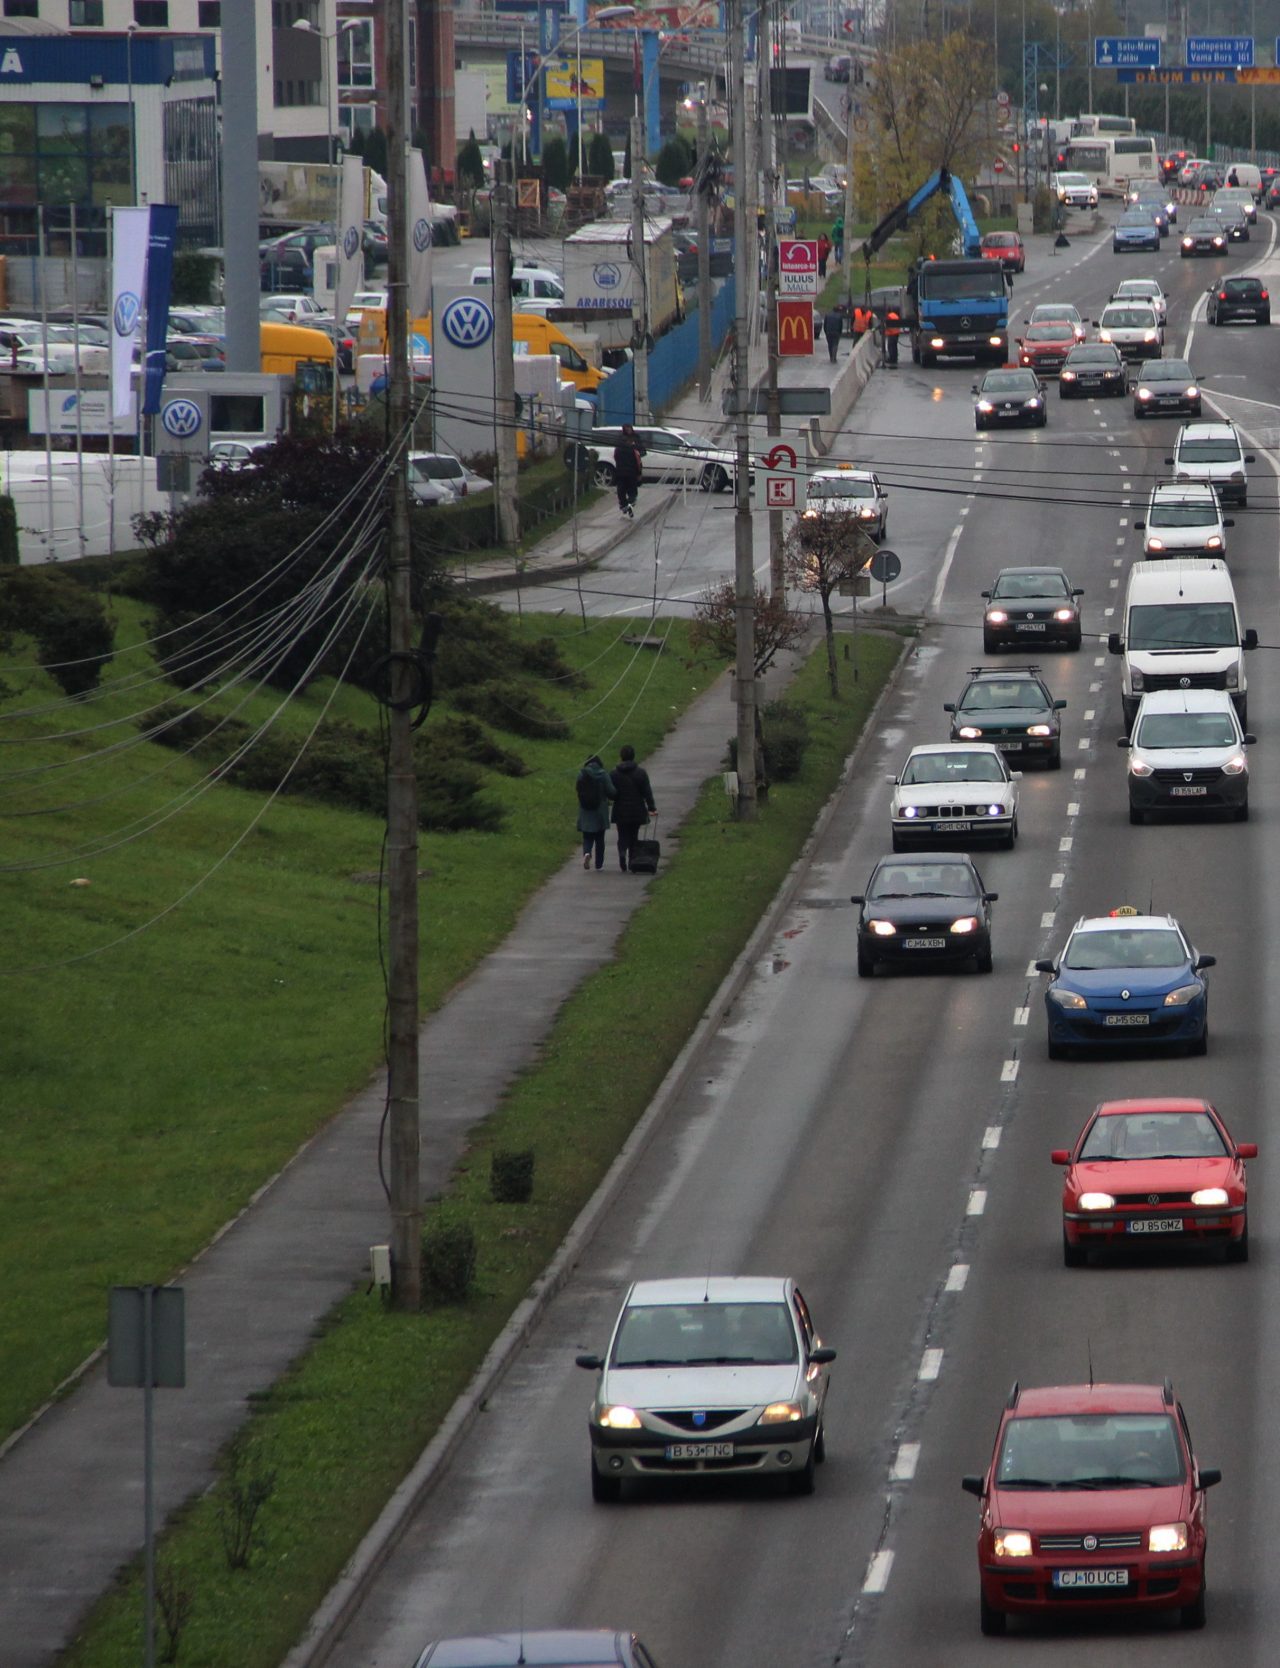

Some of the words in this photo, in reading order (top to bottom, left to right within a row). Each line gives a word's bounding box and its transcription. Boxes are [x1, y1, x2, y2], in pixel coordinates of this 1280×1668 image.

[1136, 71, 1184, 83] DRUM
[1190, 71, 1226, 83] BUN
[784, 275, 814, 283] IULIUS
[577, 297, 635, 308] ARABESQU
[1108, 1015, 1119, 1024] CJ
[1129, 1015, 1147, 1024] SCZ
[1132, 1221, 1145, 1232] CJ
[1147, 1221, 1160, 1231] 85
[1160, 1220, 1181, 1230] GMZ
[673, 1446, 682, 1457] B
[686, 1446, 700, 1457] 53
[1061, 1572, 1078, 1585] CJ
[1083, 1571, 1096, 1585] 10
[1097, 1570, 1126, 1584] UCE
